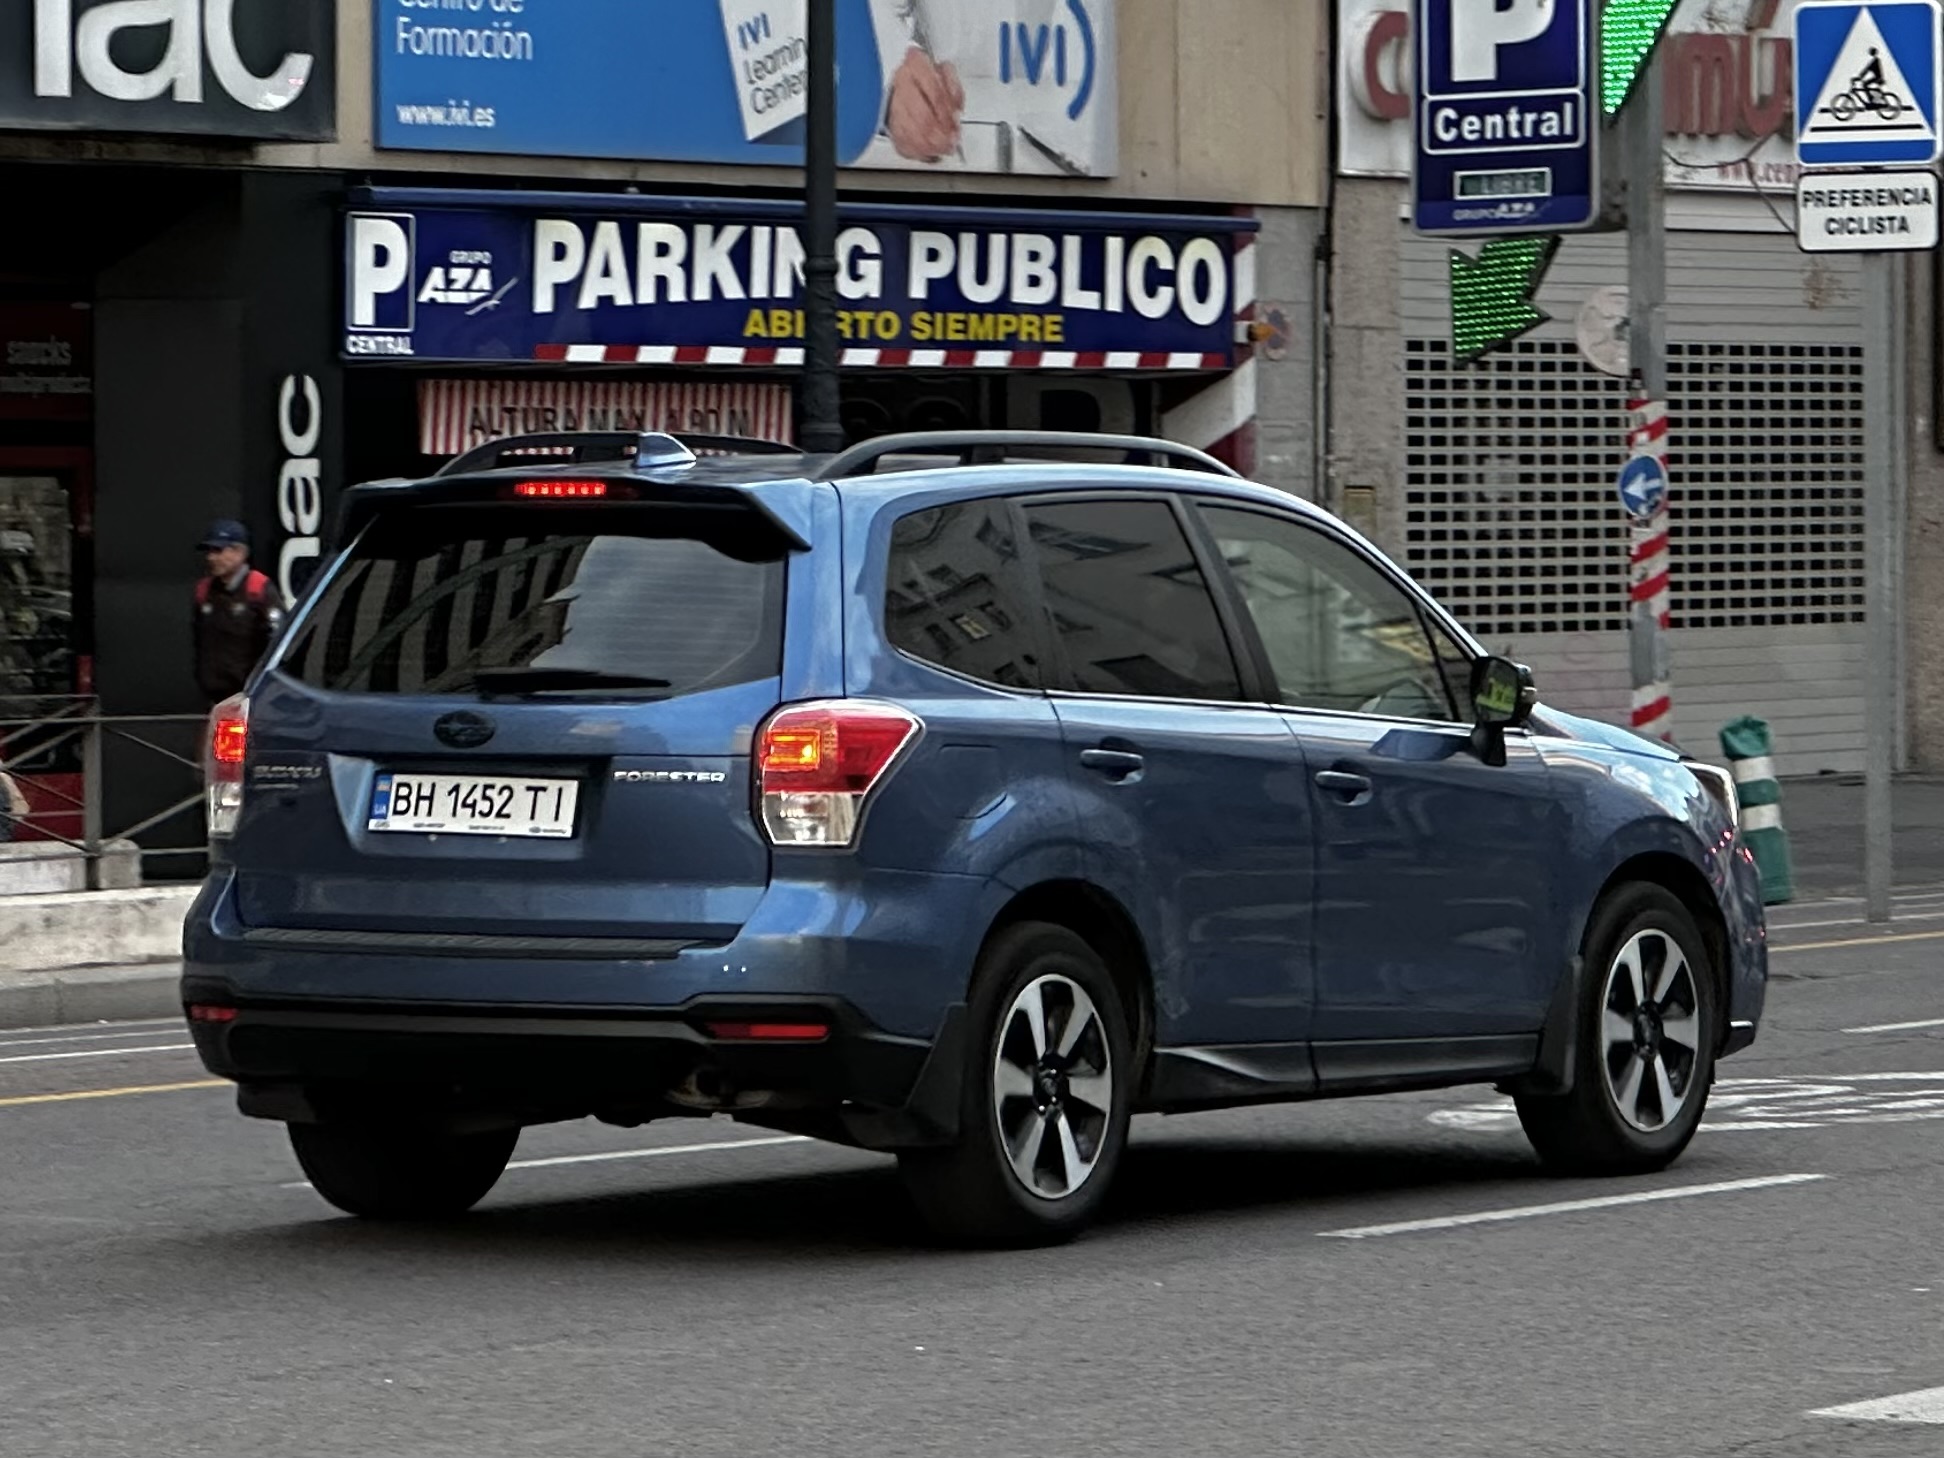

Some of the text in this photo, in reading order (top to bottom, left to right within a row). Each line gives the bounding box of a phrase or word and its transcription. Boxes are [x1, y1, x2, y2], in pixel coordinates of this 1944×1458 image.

[396, 15, 534, 60] Formación
[395, 98, 497, 129] www.ivi.es
[1434, 101, 1575, 143] Central
[1802, 187, 1933, 209] PREFERENCIA
[1824, 215, 1910, 236] CICLISTA
[353, 217, 408, 326] P
[532, 217, 1227, 326] PARKING PUBLICO
[743, 308, 1064, 343] ABIRTO SIEMPRE
[346, 335, 415, 355] CENTRAL
[612, 770, 728, 786] FORESTER
[392, 781, 437, 818] BH
[447, 783, 515, 819] 1452
